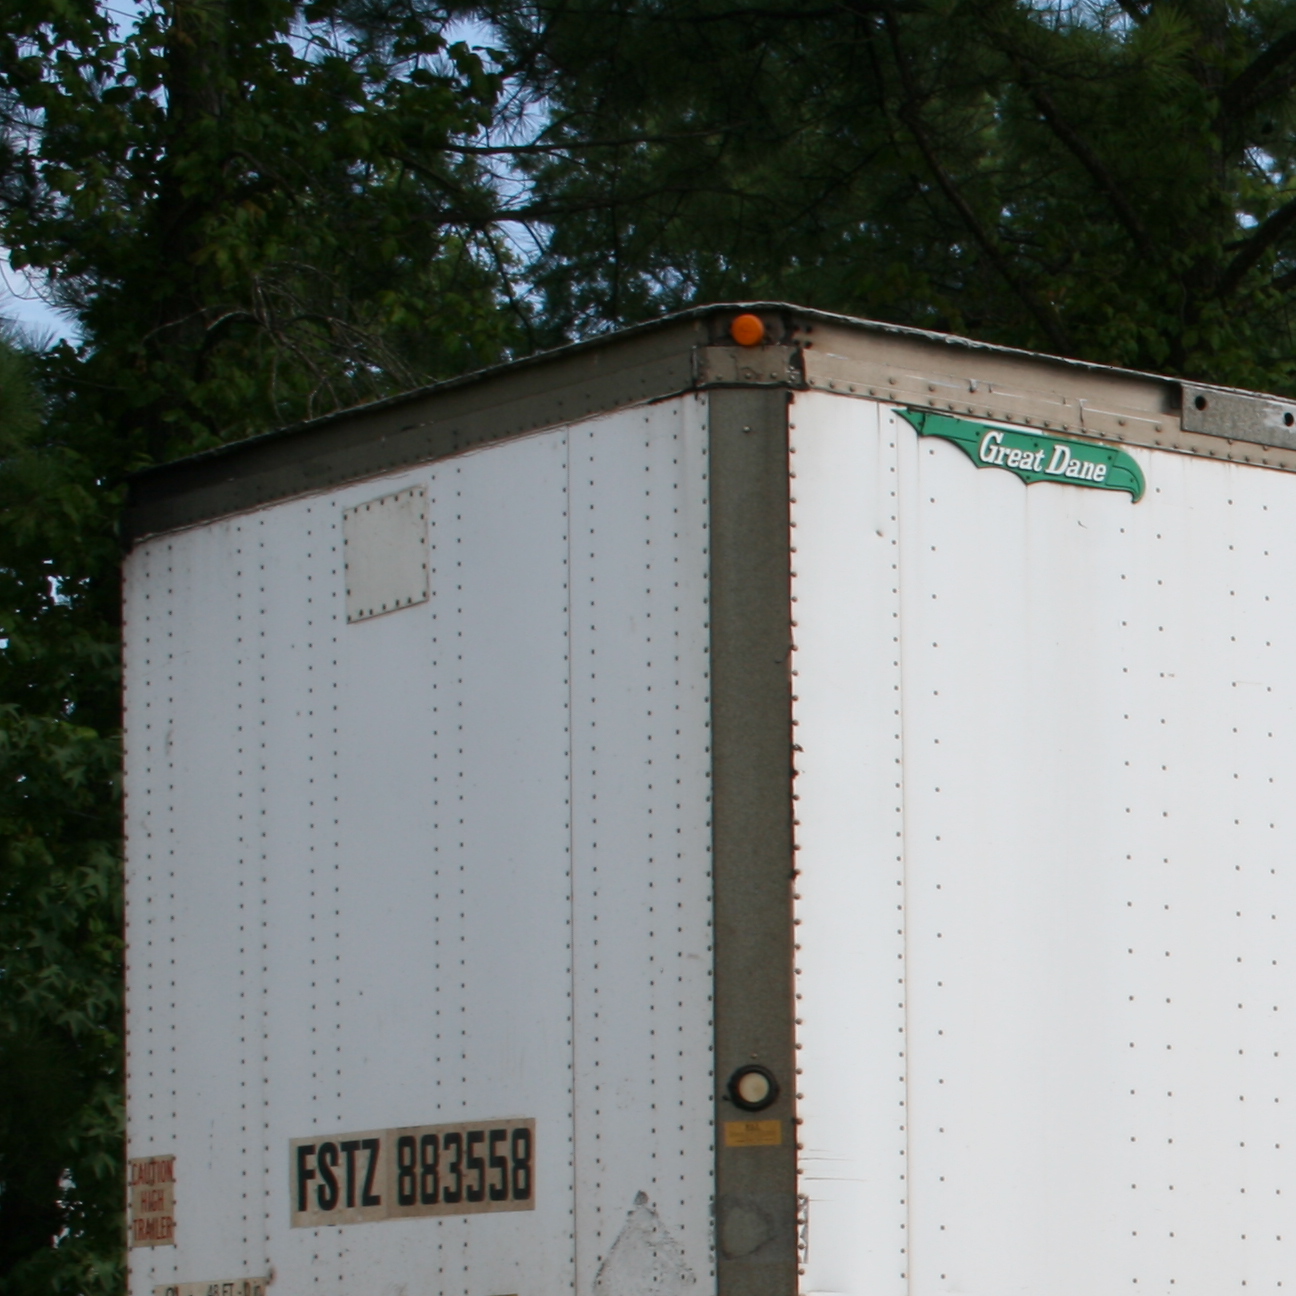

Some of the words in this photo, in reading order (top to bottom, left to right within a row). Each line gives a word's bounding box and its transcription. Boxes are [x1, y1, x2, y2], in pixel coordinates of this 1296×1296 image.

[979, 430, 1045, 472] Great
[1044, 444, 1106, 482] Dane
[132, 1161, 173, 1187] CAUTION
[297, 1138, 382, 1212] FSTZ
[397, 1128, 532, 1206] 883558
[141, 1190, 164, 1212] HIGH
[133, 1216, 173, 1240] TRAILER
